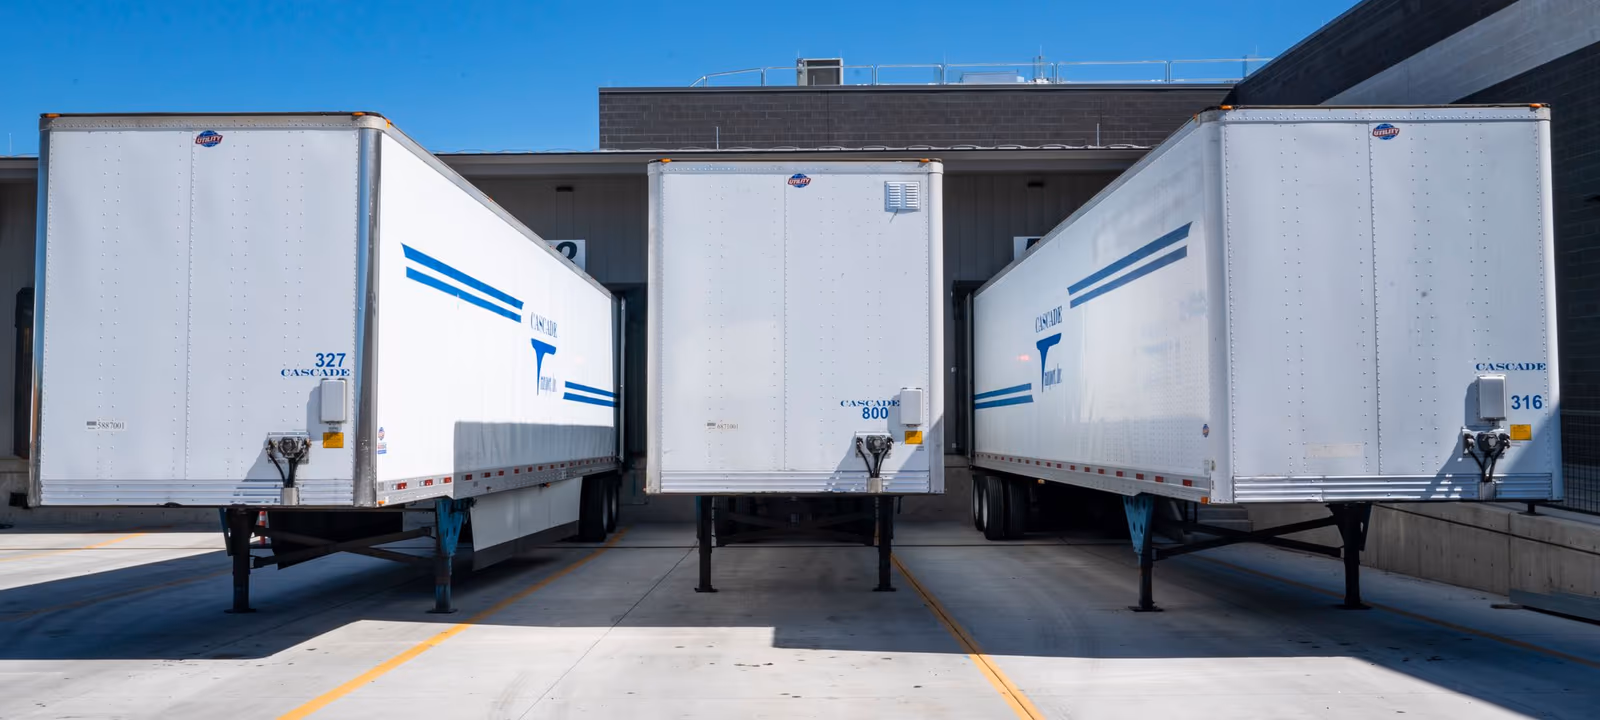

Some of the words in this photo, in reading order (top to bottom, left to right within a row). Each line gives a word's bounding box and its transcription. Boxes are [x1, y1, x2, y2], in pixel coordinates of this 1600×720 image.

[1372, 128, 1400, 137] UTILITY
[195, 135, 223, 144] UTILITY
[531, 312, 558, 339] CASCADE
[1035, 305, 1063, 333] CASCADE
[315, 352, 346, 368] 327
[1475, 362, 1547, 371] CASCADE
[280, 368, 350, 377] CASCADE
[1511, 394, 1543, 410] 316
[862, 406, 889, 419] 800
